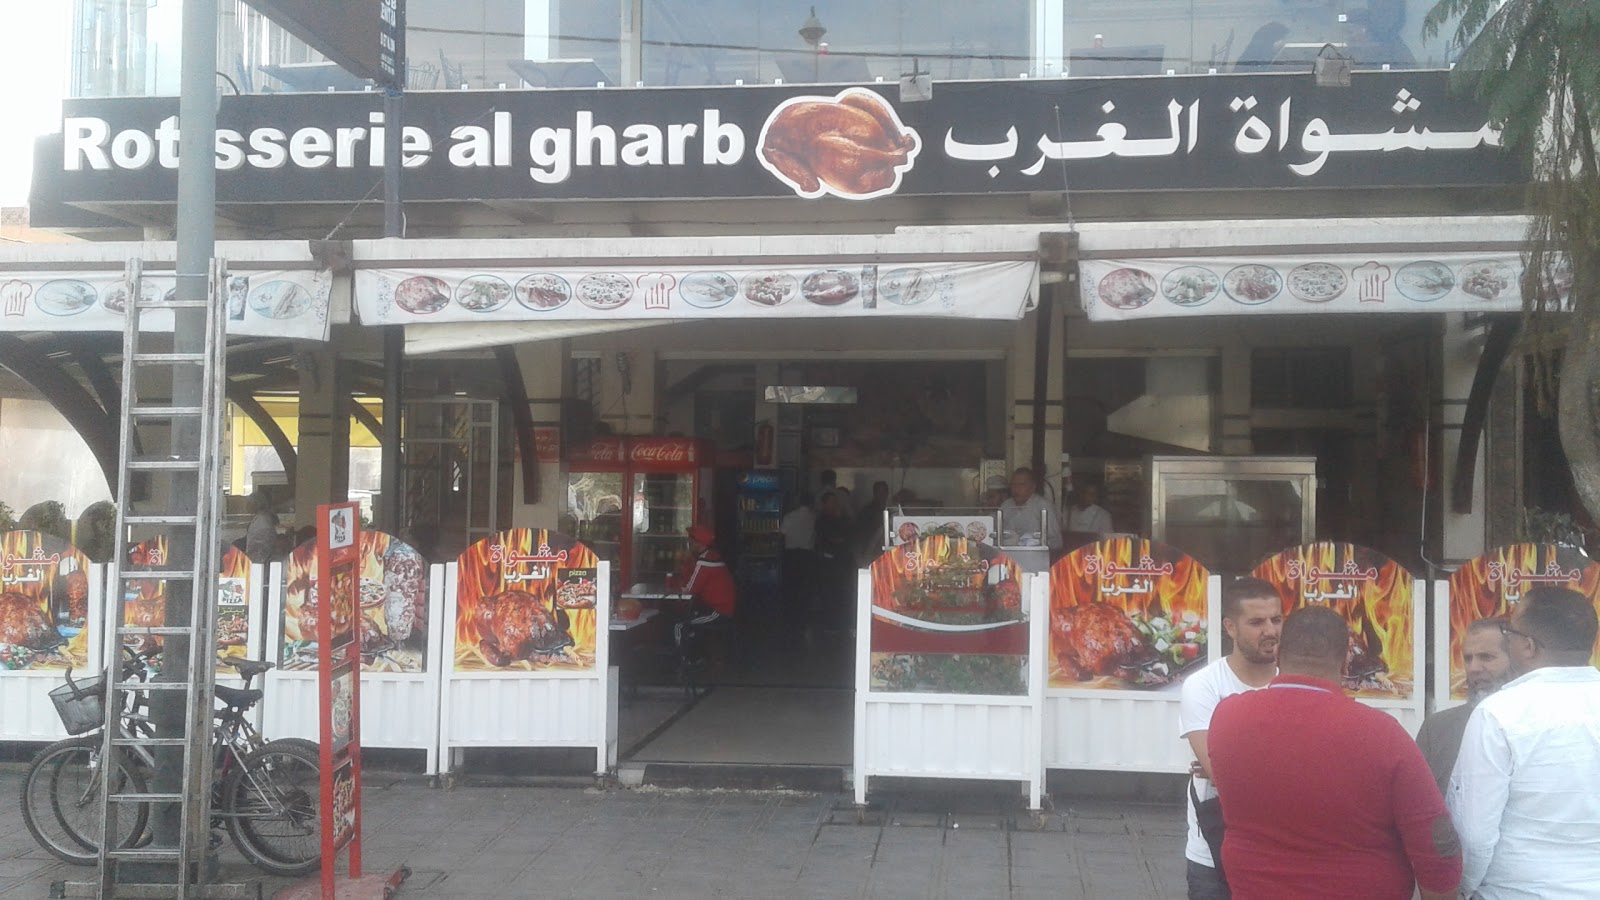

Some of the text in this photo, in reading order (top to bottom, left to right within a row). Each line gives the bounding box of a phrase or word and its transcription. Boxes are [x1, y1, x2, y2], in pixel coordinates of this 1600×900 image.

[64, 108, 746, 184] Rotsserie al gharb
[944, 97, 1200, 178] الغرب
[490, 543, 568, 568] مشواة
[1085, 554, 1174, 579] مشواة
[1, 568, 44, 585] الغرب
[503, 565, 550, 584] الغرب
[568, 568, 587, 577] pizza
[1287, 560, 1378, 585] مشواة
[1487, 560, 1581, 587] مشواة
[1100, 578, 1154, 596] الغرب
[1304, 583, 1358, 602] الغرب
[222, 596, 243, 604] PIZZA
